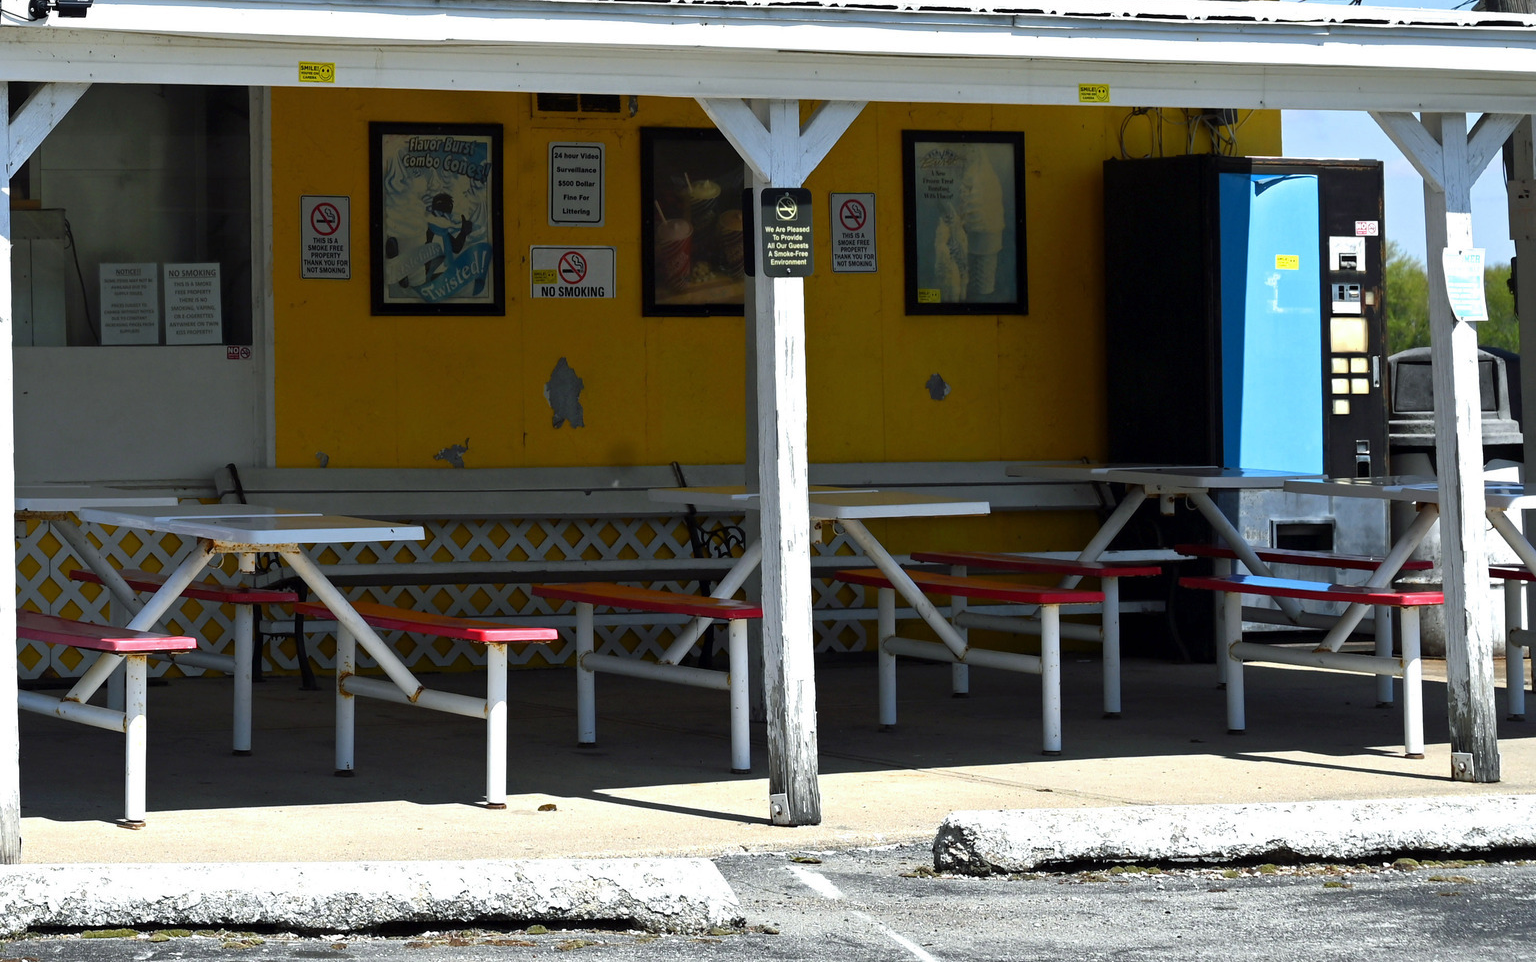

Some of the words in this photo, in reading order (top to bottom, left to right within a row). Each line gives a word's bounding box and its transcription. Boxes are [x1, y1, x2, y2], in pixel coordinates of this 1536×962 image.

[408, 136, 442, 152] Flavor
[443, 136, 477, 156] Burst
[562, 208, 590, 216] Littering
[421, 250, 487, 300] Twisted!
[541, 286, 555, 297] NO
[558, 286, 605, 297] SMOKING
